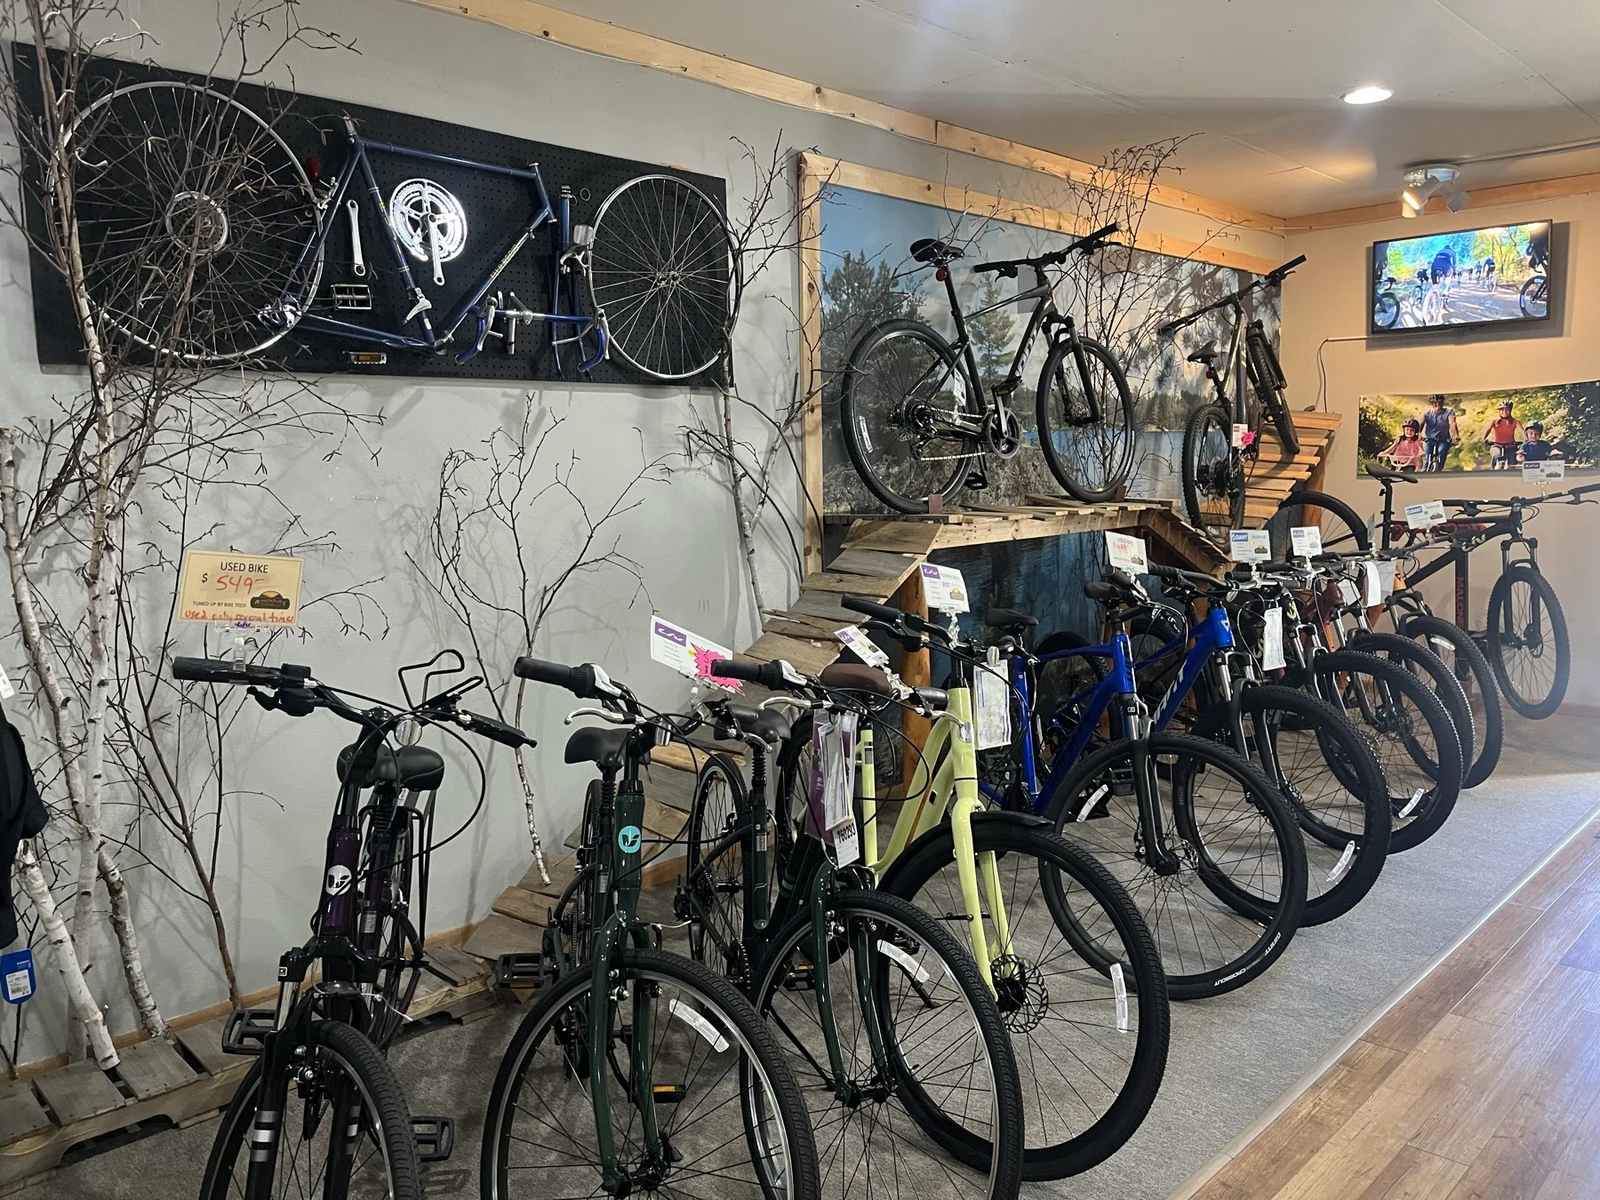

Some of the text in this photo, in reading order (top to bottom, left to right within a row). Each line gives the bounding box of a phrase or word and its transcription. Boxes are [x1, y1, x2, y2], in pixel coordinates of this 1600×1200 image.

[220, 562, 269, 573] USED BIKE
[201, 572, 208, 583] $
[836, 822, 856, 843] 760293
